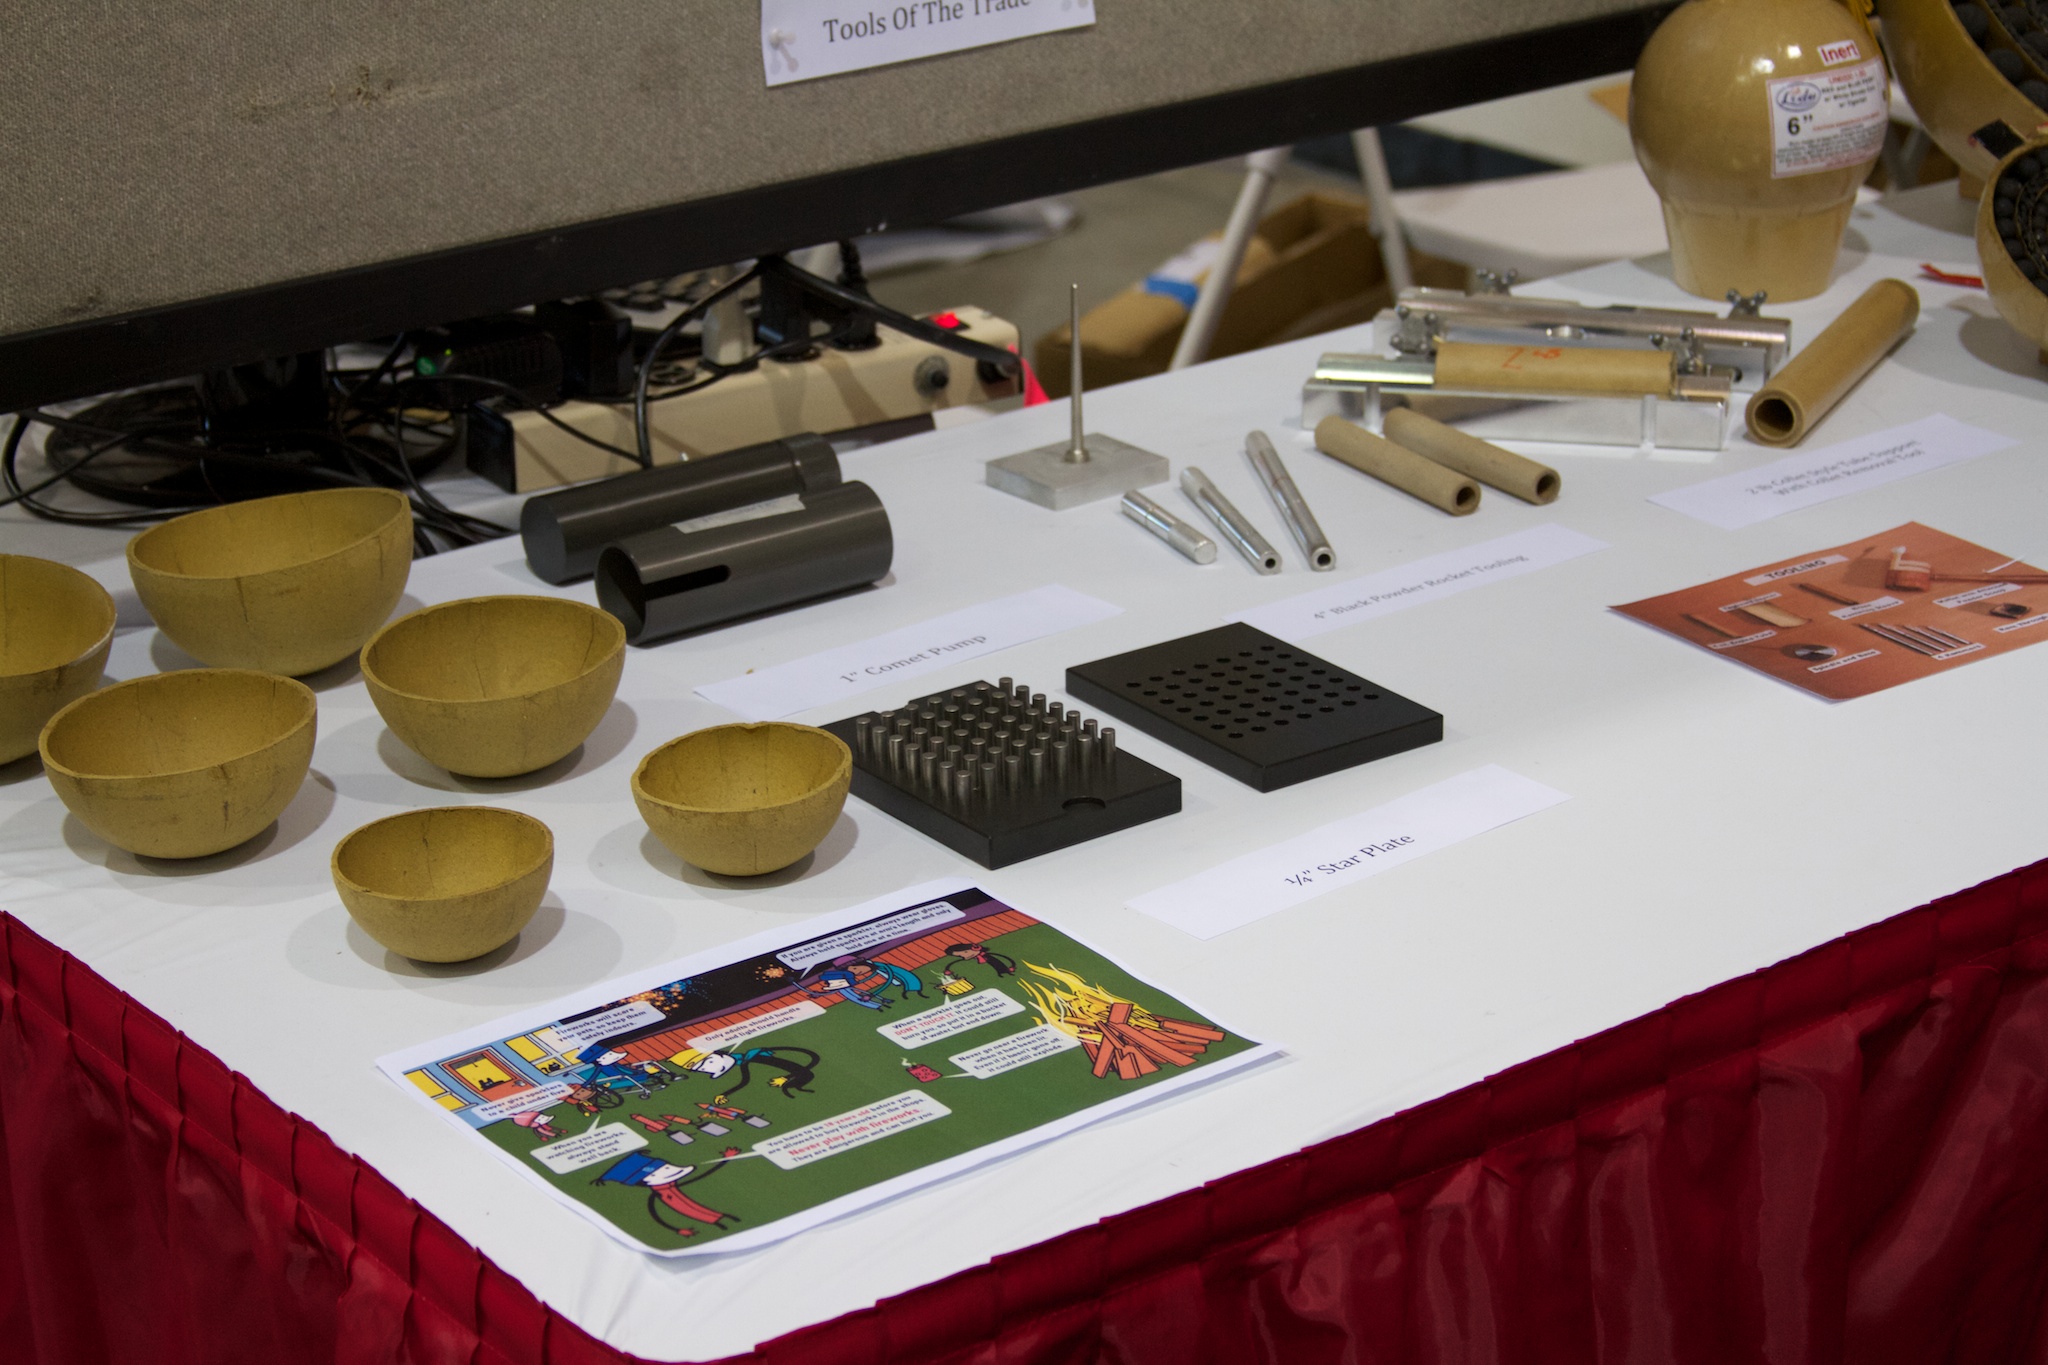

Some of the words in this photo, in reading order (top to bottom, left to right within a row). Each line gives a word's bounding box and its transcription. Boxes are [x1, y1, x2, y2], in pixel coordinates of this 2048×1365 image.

[823, 12, 887, 43] Tools
[892, 4, 918, 31] Of
[922, 1, 964, 25] The
[1764, 558, 1828, 582] TOOLING
[1330, 598, 1372, 616] Black
[1370, 583, 1425, 604] Powder
[1424, 568, 1474, 588] Rocket
[1469, 554, 1530, 573] Tooling
[865, 650, 932, 678] Comet
[929, 634, 988, 657] Pump
[1317, 854, 1362, 876] Star
[1359, 834, 1416, 858] Plate
[788, 949, 803, 957] you
[816, 938, 837, 948] given
[874, 917, 901, 928] always
[900, 911, 920, 919] wear
[790, 951, 818, 962] Always
[816, 944, 835, 953] hold
[835, 934, 870, 947] sparklers
[896, 917, 921, 927] length
[921, 912, 935, 920] and
[844, 942, 863, 950] hold
[555, 1020, 596, 1035] Fireworks
[595, 1014, 612, 1022] will
[612, 1007, 634, 1017] scare
[557, 1033, 575, 1042] your
[605, 1017, 626, 1026] keep
[625, 1010, 646, 1019] them
[704, 1032, 724, 1041] Only
[724, 1025, 748, 1034] adults
[748, 1015, 774, 1026] should
[773, 1007, 800, 1017] handle
[892, 1019, 916, 1029] When
[922, 1006, 953, 1019] sparkler
[953, 1000, 972, 1009] goes
[901, 1032, 921, 1040] burn
[979, 1002, 1006, 1013] bucket
[918, 1015, 946, 1027] TOUCH
[962, 1002, 984, 1012] could
[983, 996, 999, 1005] still
[951, 1022, 965, 1030] hot
[965, 1017, 980, 1025] end
[580, 1031, 605, 1041] safely
[724, 1033, 739, 1041] and
[737, 1027, 757, 1036] light
[957, 1051, 981, 1061] Never
[992, 1041, 1010, 1049] near
[1015, 1028, 1048, 1041] firework
[973, 1061, 994, 1070] Even
[1030, 1042, 1049, 1051] gone
[974, 1053, 997, 1062] when
[1001, 1045, 1018, 1053] has
[1016, 1039, 1037, 1047] been
[995, 1059, 1017, 1070] could
[1016, 1054, 1032, 1062] still
[480, 1102, 505, 1112] Never
[507, 1096, 524, 1104] give
[525, 1083, 562, 1097] sparklers
[505, 1101, 526, 1111] child
[526, 1094, 549, 1104] under
[782, 1132, 803, 1141] have
[834, 1114, 857, 1124] years
[869, 1101, 896, 1112] before
[896, 1095, 911, 1103] you
[782, 1135, 815, 1149] allowed
[822, 1127, 840, 1135] buy
[838, 1114, 878, 1129] fireworks
[546, 1144, 586, 1159] watching
[551, 1141, 576, 1150] When
[577, 1135, 592, 1143] you
[567, 1148, 596, 1160] always
[597, 1139, 620, 1149] stand
[787, 1142, 821, 1155] Never
[821, 1134, 845, 1146] play
[845, 1125, 870, 1136] with
[791, 1153, 813, 1162] They
[827, 1134, 869, 1150] dangerous
[870, 1127, 885, 1136] and
[899, 1116, 917, 1125] hurt
[578, 1153, 598, 1163] well
